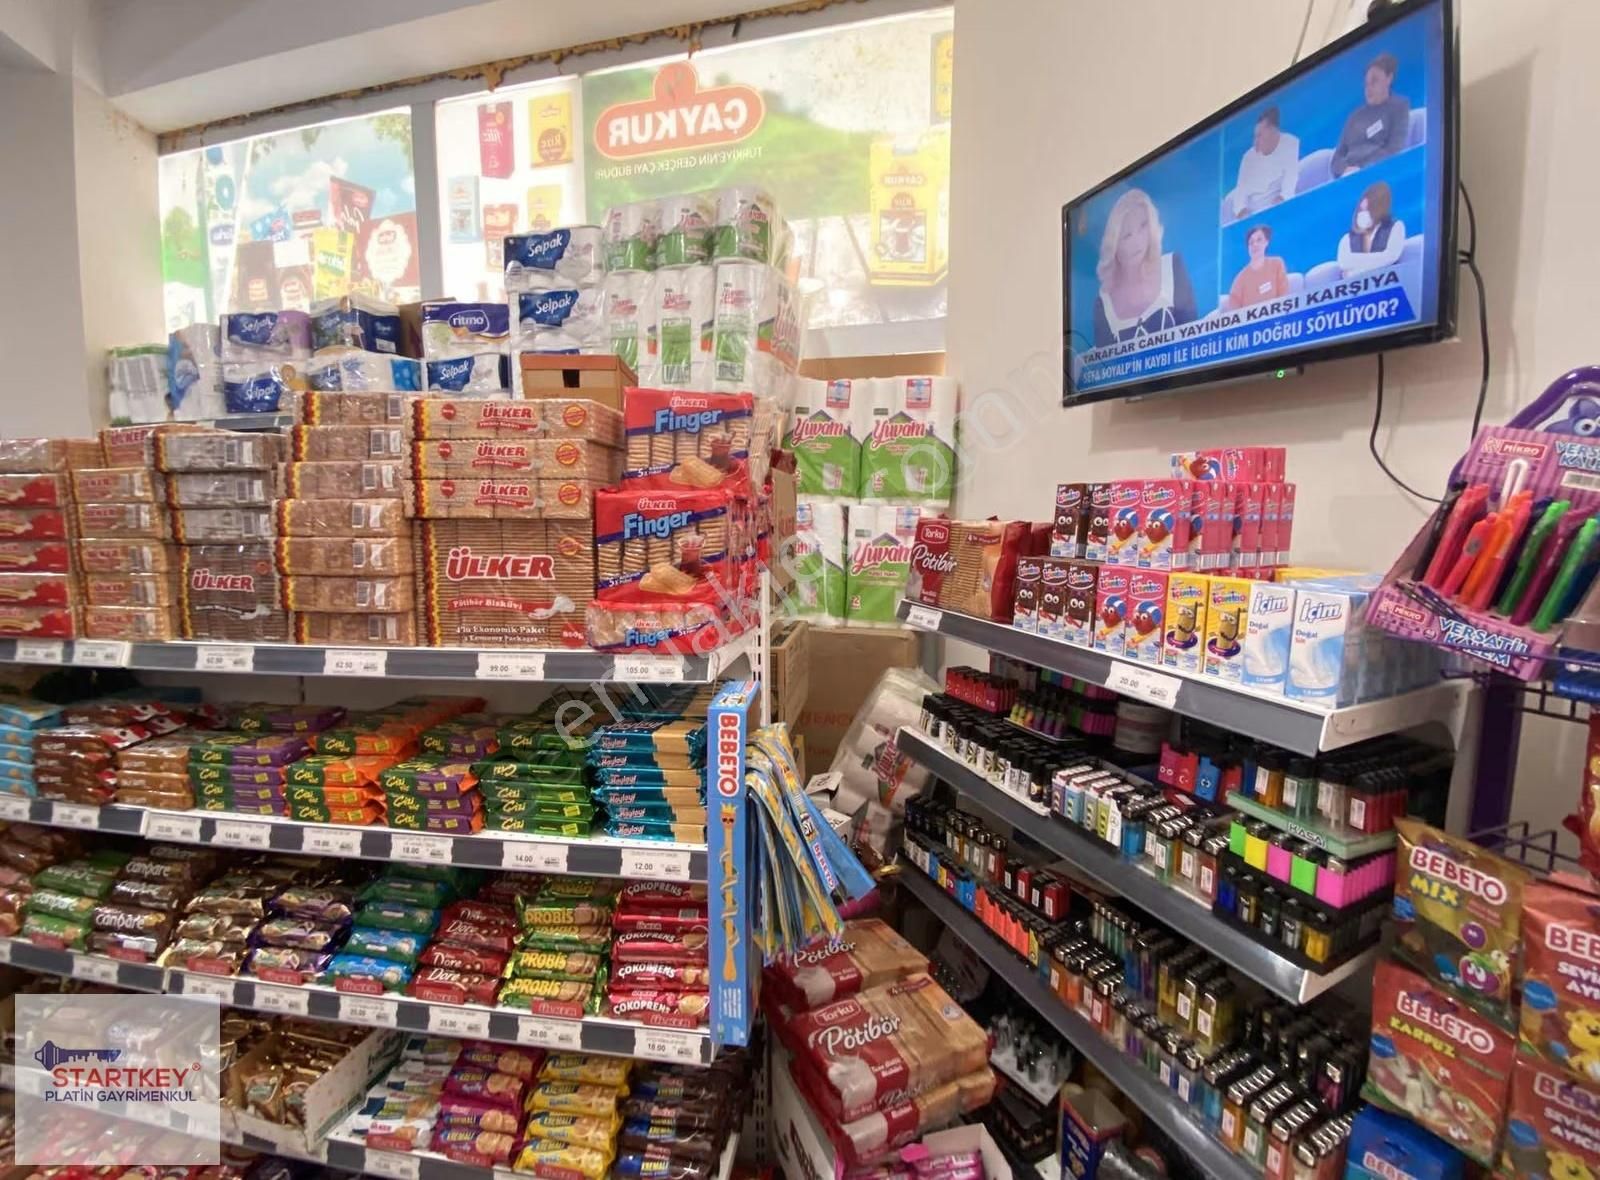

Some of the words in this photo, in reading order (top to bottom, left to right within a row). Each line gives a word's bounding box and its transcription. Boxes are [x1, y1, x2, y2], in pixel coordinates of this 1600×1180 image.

[535, 293, 572, 315] Selpak
[1138, 331, 1176, 349] CANLI
[1179, 313, 1241, 339] YAYINDA
[1246, 298, 1300, 322] KARŞI
[1305, 270, 1400, 308] KARŞIYA
[452, 312, 484, 326] ritmo
[1144, 354, 1171, 370] KAYBI
[1173, 349, 1189, 364] İLE
[1191, 336, 1223, 361] İLGİLİ
[1225, 330, 1249, 352] KİM
[1252, 317, 1302, 348] DOĞRU
[1305, 298, 1400, 335] SÖYLÜYOR?
[482, 402, 533, 419] ÜLKER
[655, 409, 722, 434] Finger
[871, 419, 928, 450] Yuvam
[476, 441, 526, 457] ÜLKER
[479, 480, 529, 496] ÜLKER
[637, 498, 677, 511] ÜLKER
[623, 510, 692, 540] Finger
[446, 546, 556, 581] ÜLKER
[851, 542, 912, 577] Yuvam
[192, 568, 255, 593] ÜLKER
[624, 627, 671, 647] Finger
[717, 712, 741, 798] BEBETO
[634, 862, 654, 871] 12.00
[1410, 846, 1507, 905] BEBETO
[793, 940, 857, 969] Pötibör
[820, 1003, 855, 1022] Torku
[1397, 990, 1494, 1055] BEBETO
[819, 1014, 902, 1056] Pötibör
